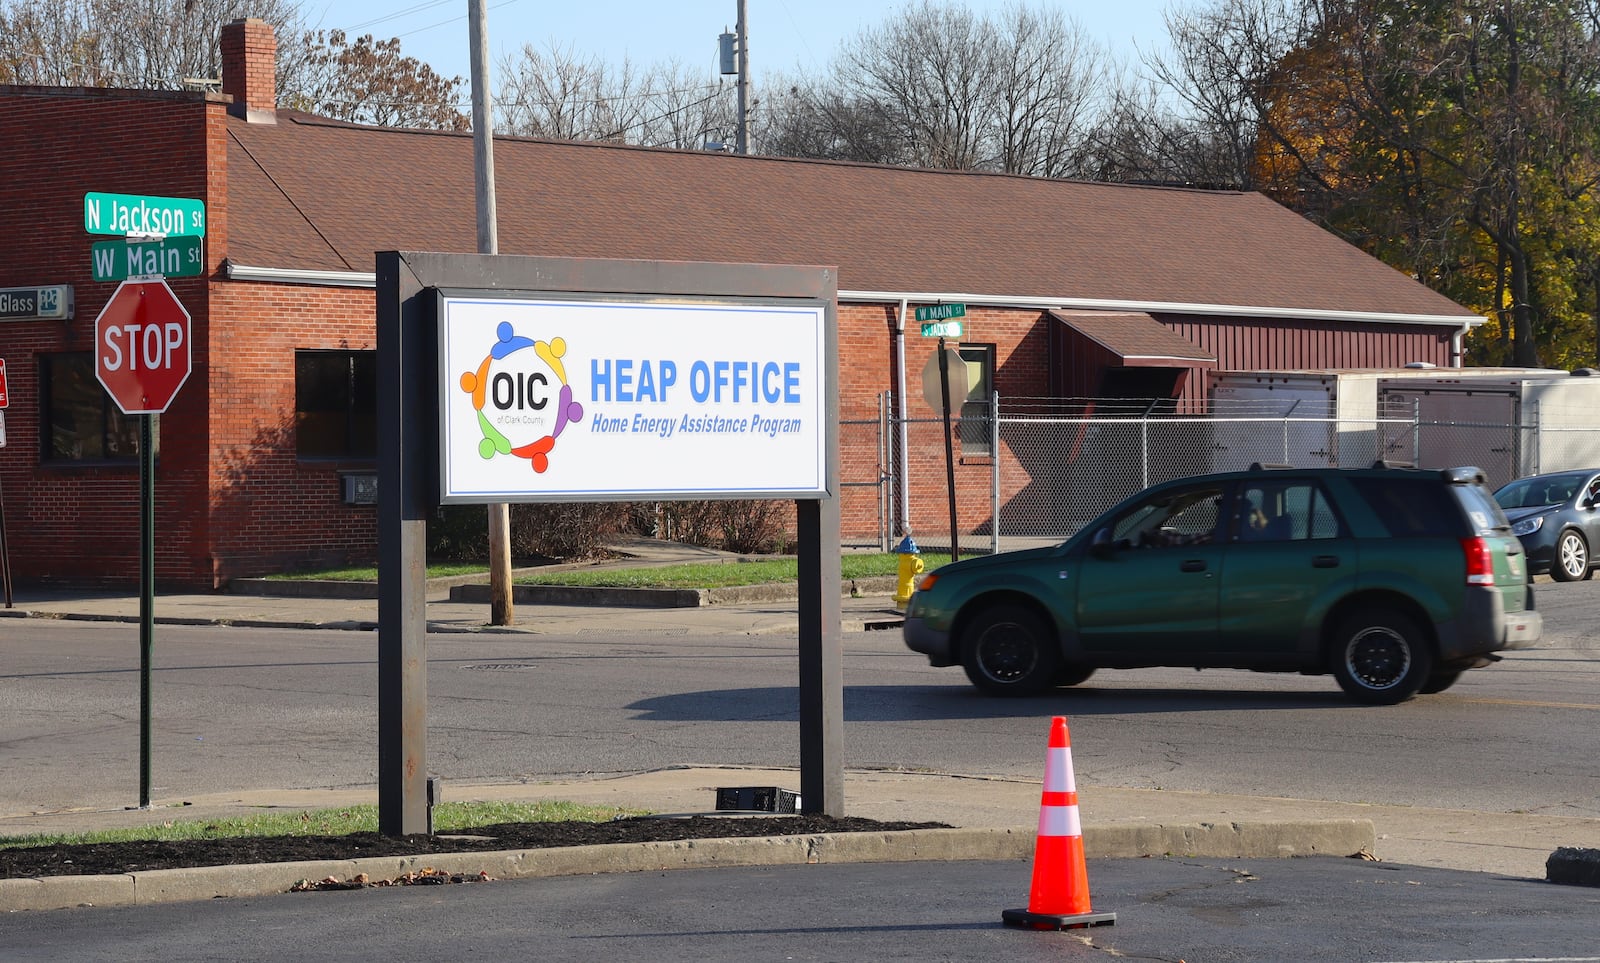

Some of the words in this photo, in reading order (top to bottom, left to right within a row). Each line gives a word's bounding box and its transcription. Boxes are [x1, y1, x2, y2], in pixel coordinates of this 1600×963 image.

[88, 199, 100, 230] N
[109, 199, 184, 234] Jackson
[192, 211, 202, 227] St
[95, 248, 114, 278] W
[127, 241, 180, 276] Main
[188, 247, 200, 263] St
[0, 294, 33, 312] Glass
[920, 308, 926, 320] W
[930, 305, 952, 319] MAIN
[103, 322, 183, 371] STOP
[492, 372, 548, 410] OIC
[591, 359, 677, 402] HEAP
[690, 360, 800, 403] OFFICE
[497, 416, 504, 424] of
[505, 415, 521, 424] Clark
[522, 415, 544, 426] County
[591, 413, 628, 433] Home
[631, 413, 677, 437] Energy
[679, 414, 747, 433] Assistance
[750, 414, 801, 437] Program
